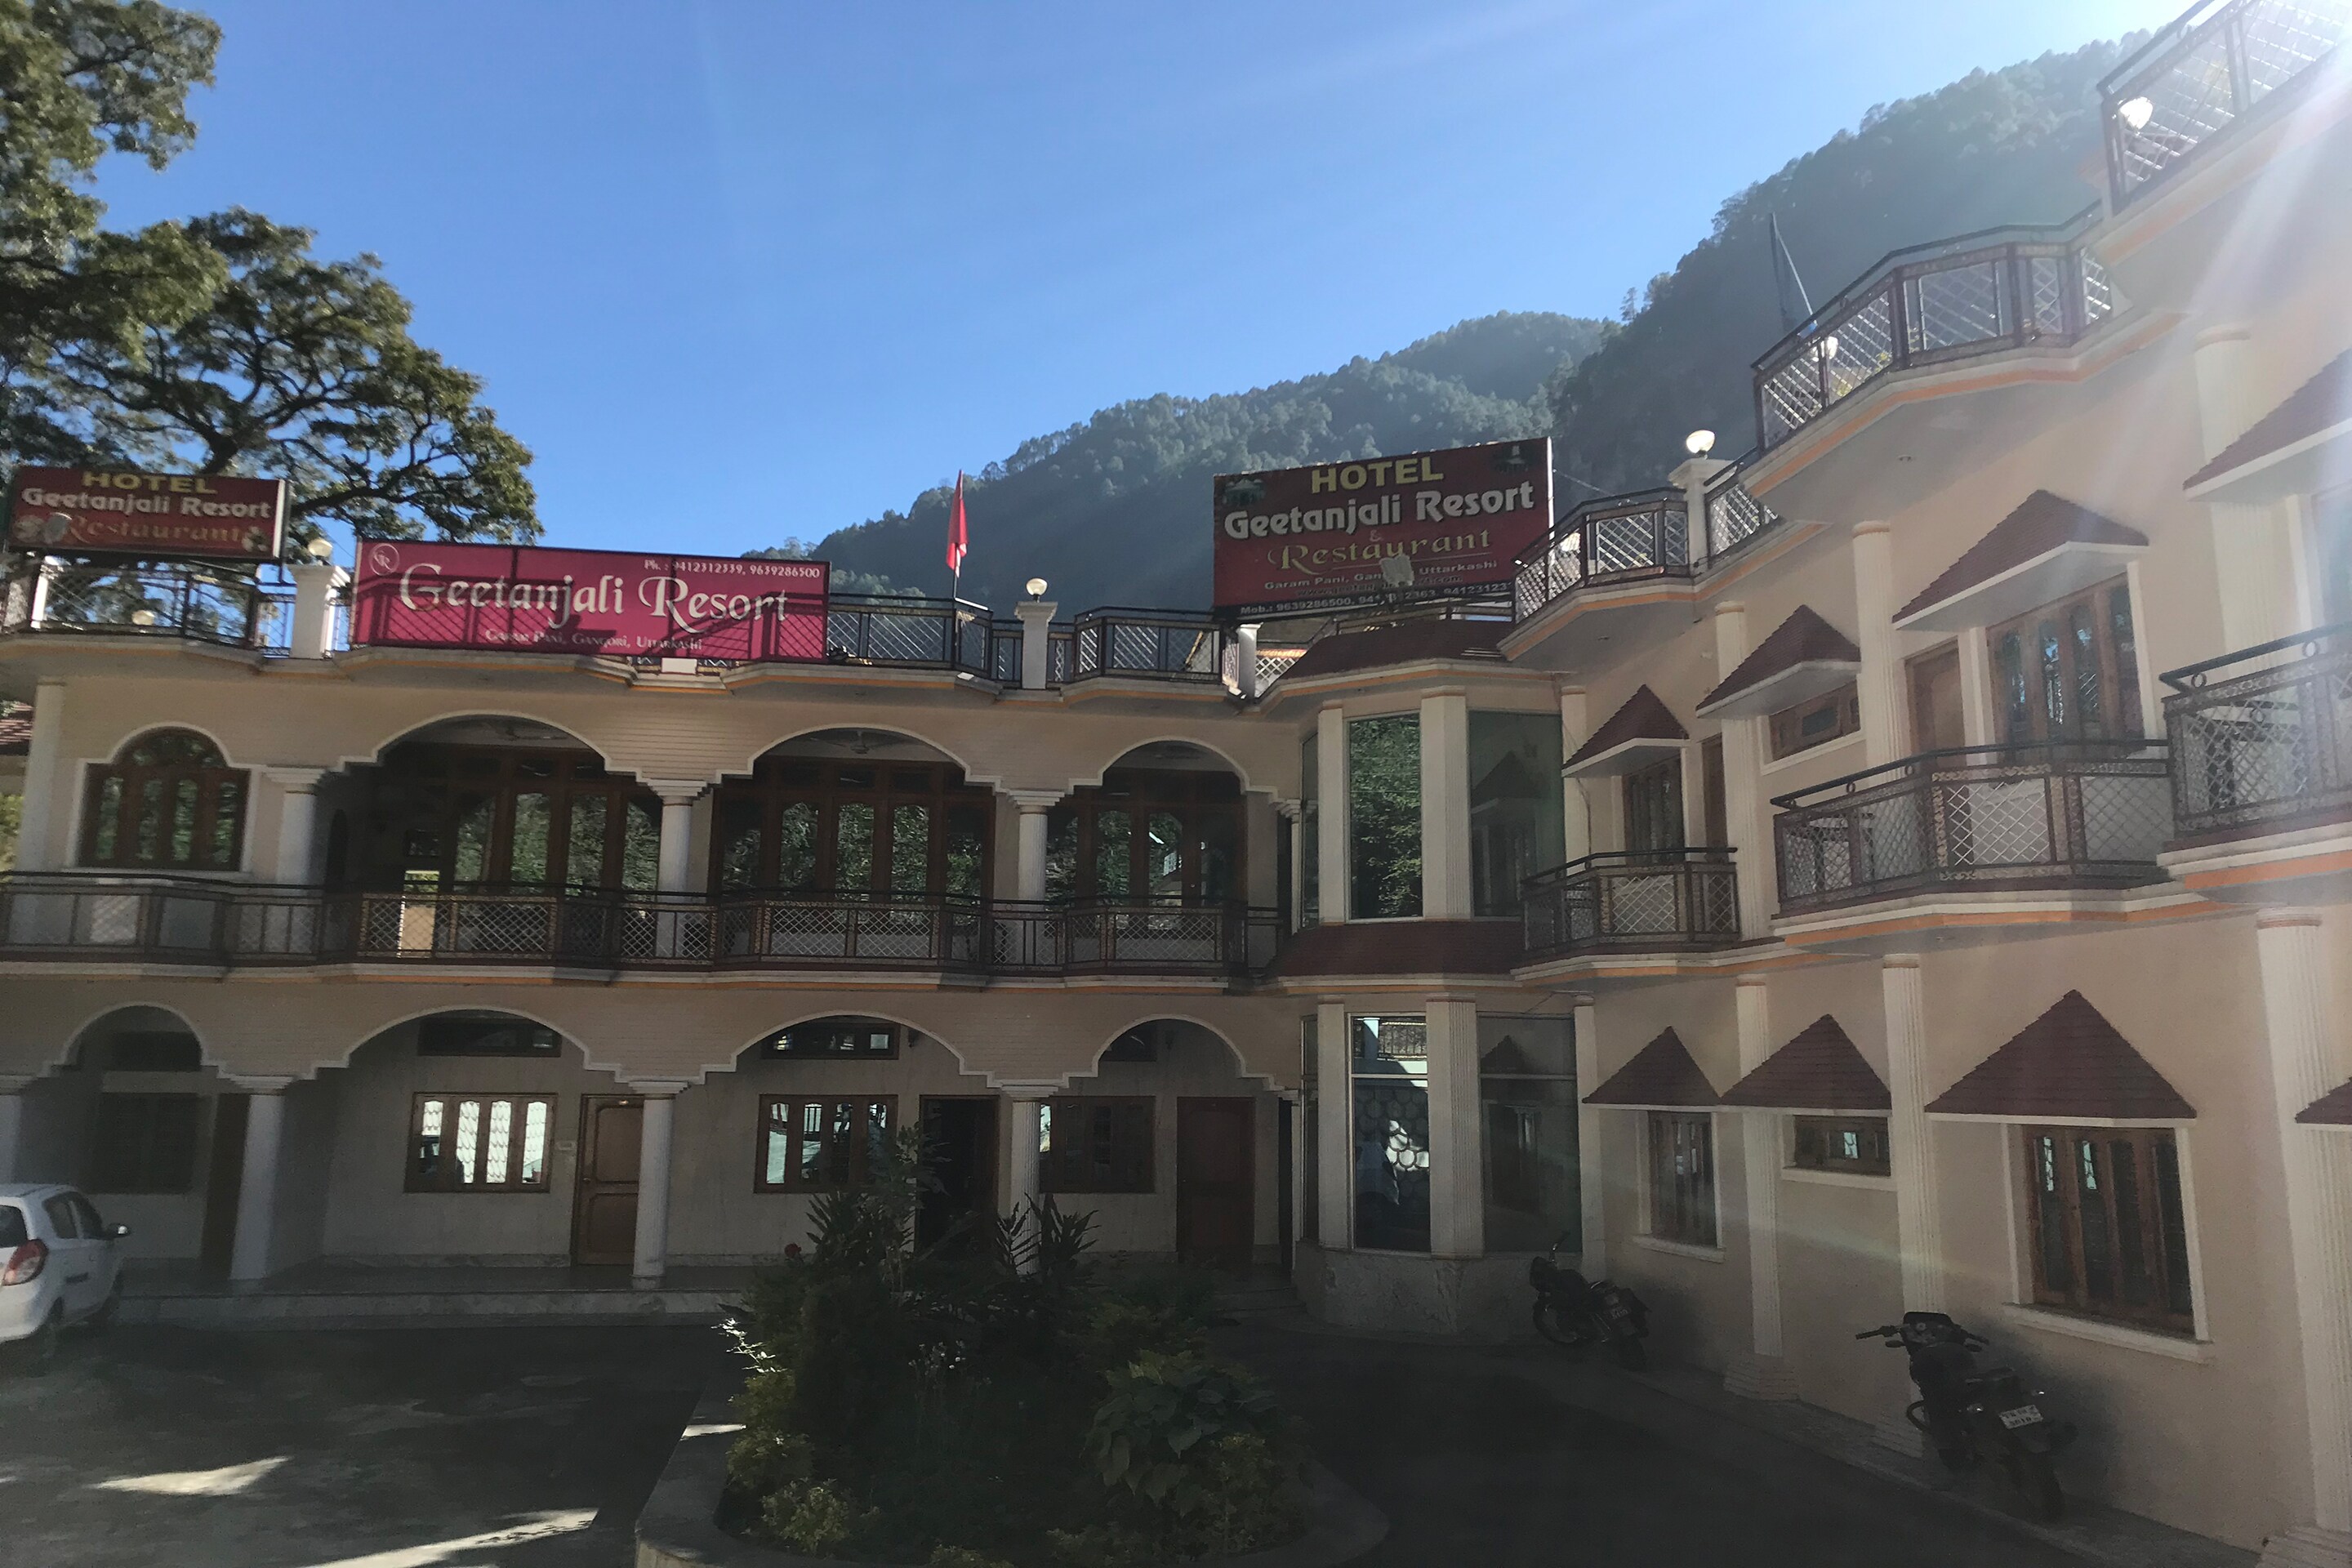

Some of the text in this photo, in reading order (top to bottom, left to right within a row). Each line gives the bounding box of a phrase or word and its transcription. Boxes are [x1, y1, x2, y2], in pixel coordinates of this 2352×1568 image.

[81, 470, 219, 495] HOTEL
[1311, 457, 1445, 494] HOTEL
[21, 487, 273, 519] Geetanjali Resort
[1224, 479, 1535, 541] Geetanjali Resort
[1369, 528, 1384, 542] &
[1267, 529, 1492, 576] Restaurant
[749, 564, 821, 579] 9639286500
[1263, 580, 1310, 590] Garam
[1419, 560, 1498, 575] Uttarkashi
[399, 562, 788, 635] Geetanjali Resort
